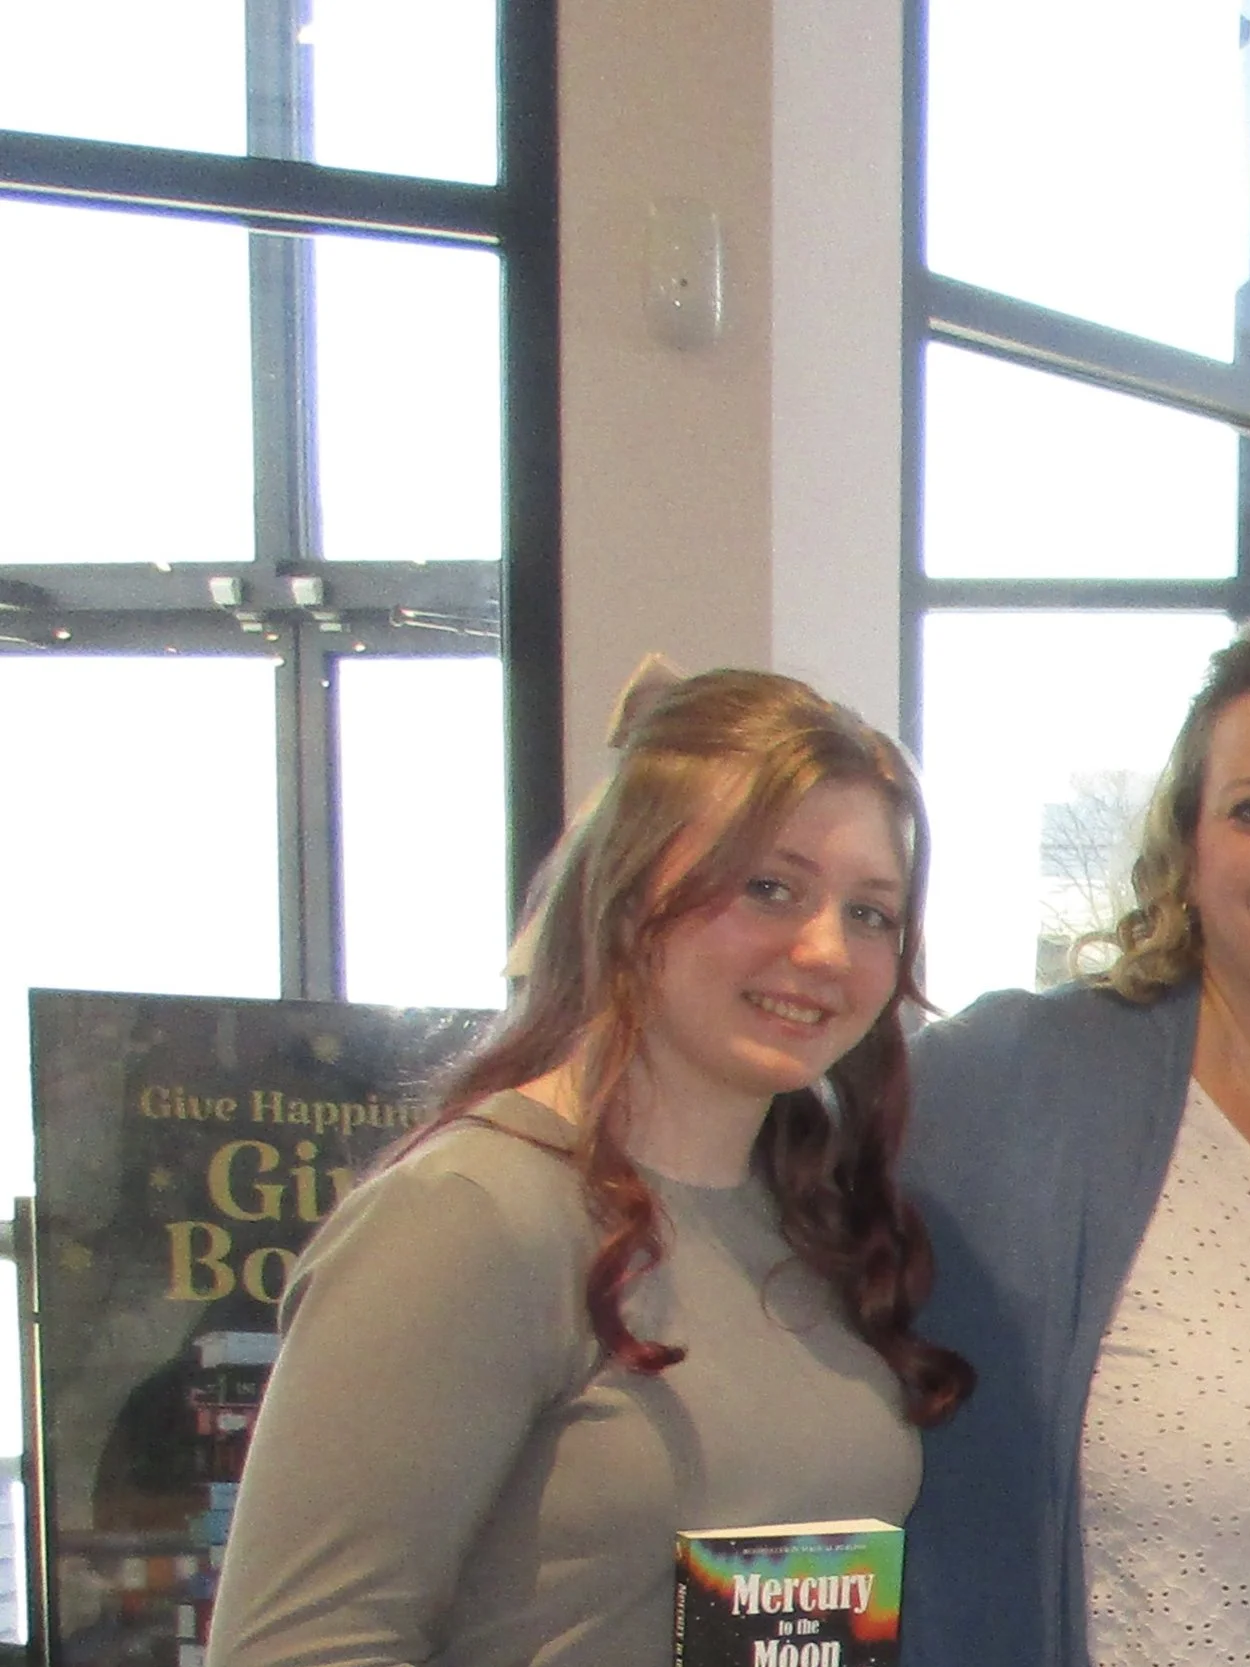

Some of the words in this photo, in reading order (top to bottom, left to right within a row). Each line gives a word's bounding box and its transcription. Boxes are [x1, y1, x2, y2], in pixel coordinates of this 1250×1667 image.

[138, 1085, 238, 1122] Give
[732, 1573, 875, 1616] Mercury
[778, 1620, 793, 1636] to
[797, 1618, 820, 1636] the
